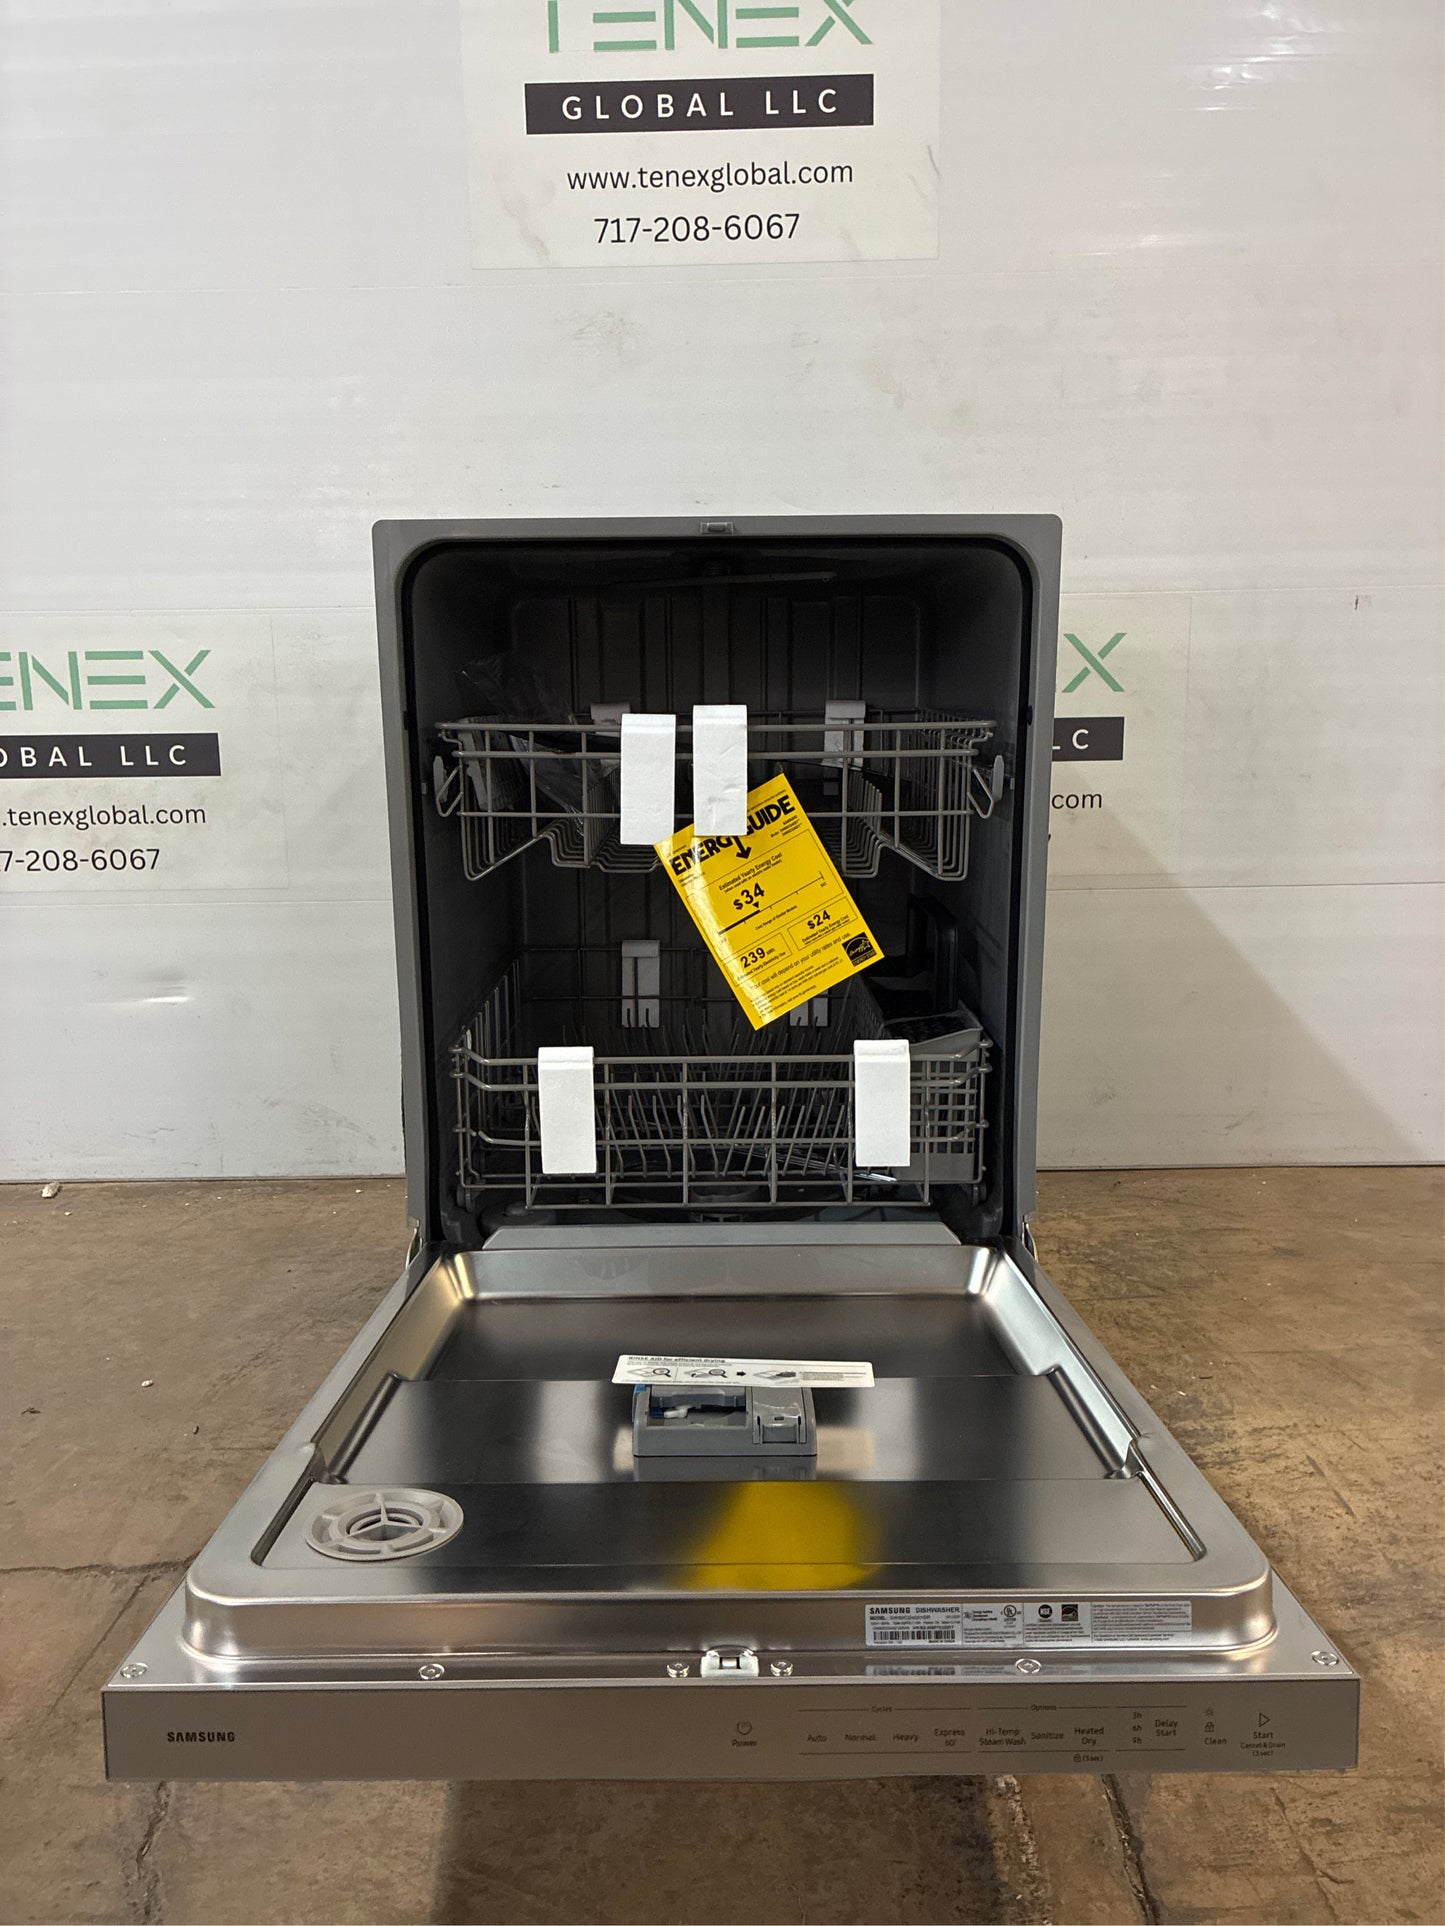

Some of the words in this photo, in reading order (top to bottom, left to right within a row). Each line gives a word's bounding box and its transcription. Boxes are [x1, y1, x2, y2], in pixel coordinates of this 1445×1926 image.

[562, 93, 733, 120] GLOBAL
[766, 89, 837, 115] LLC
[567, 161, 853, 193] www.tenexglobal.com
[594, 214, 800, 244] 717-208-6067
[0, 650, 216, 710] NEX
[121, 745, 187, 766] LLC
[718, 874, 741, 890] Estimated
[740, 866, 755, 879] Yearly
[754, 857, 771, 871] Energy
[770, 851, 782, 861] Cost
[733, 882, 766, 910] $34
[806, 910, 831, 930] $24
[740, 947, 766, 968] 239
[776, 963, 794, 976] depend
[799, 954, 810, 964] your
[808, 947, 822, 958] utility
[820, 941, 833, 951] rates
[832, 936, 841, 944] and
[1155, 1719, 1178, 1729] Delay
[934, 1728, 966, 1737] Express
[986, 1728, 1020, 1736] Hi-Temp
[1031, 1731, 1064, 1740] Sanitize
[1074, 1726, 1104, 1735] Heated
[1156, 1729, 1177, 1737] Start
[1253, 1731, 1274, 1740] Start
[167, 1731, 235, 1743] SAMSUNG
[807, 1734, 827, 1742] Auto
[893, 1733, 918, 1743] Heavy
[1081, 1737, 1097, 1746] Dry
[1204, 1737, 1227, 1745] Clean
[731, 1739, 757, 1747] Power
